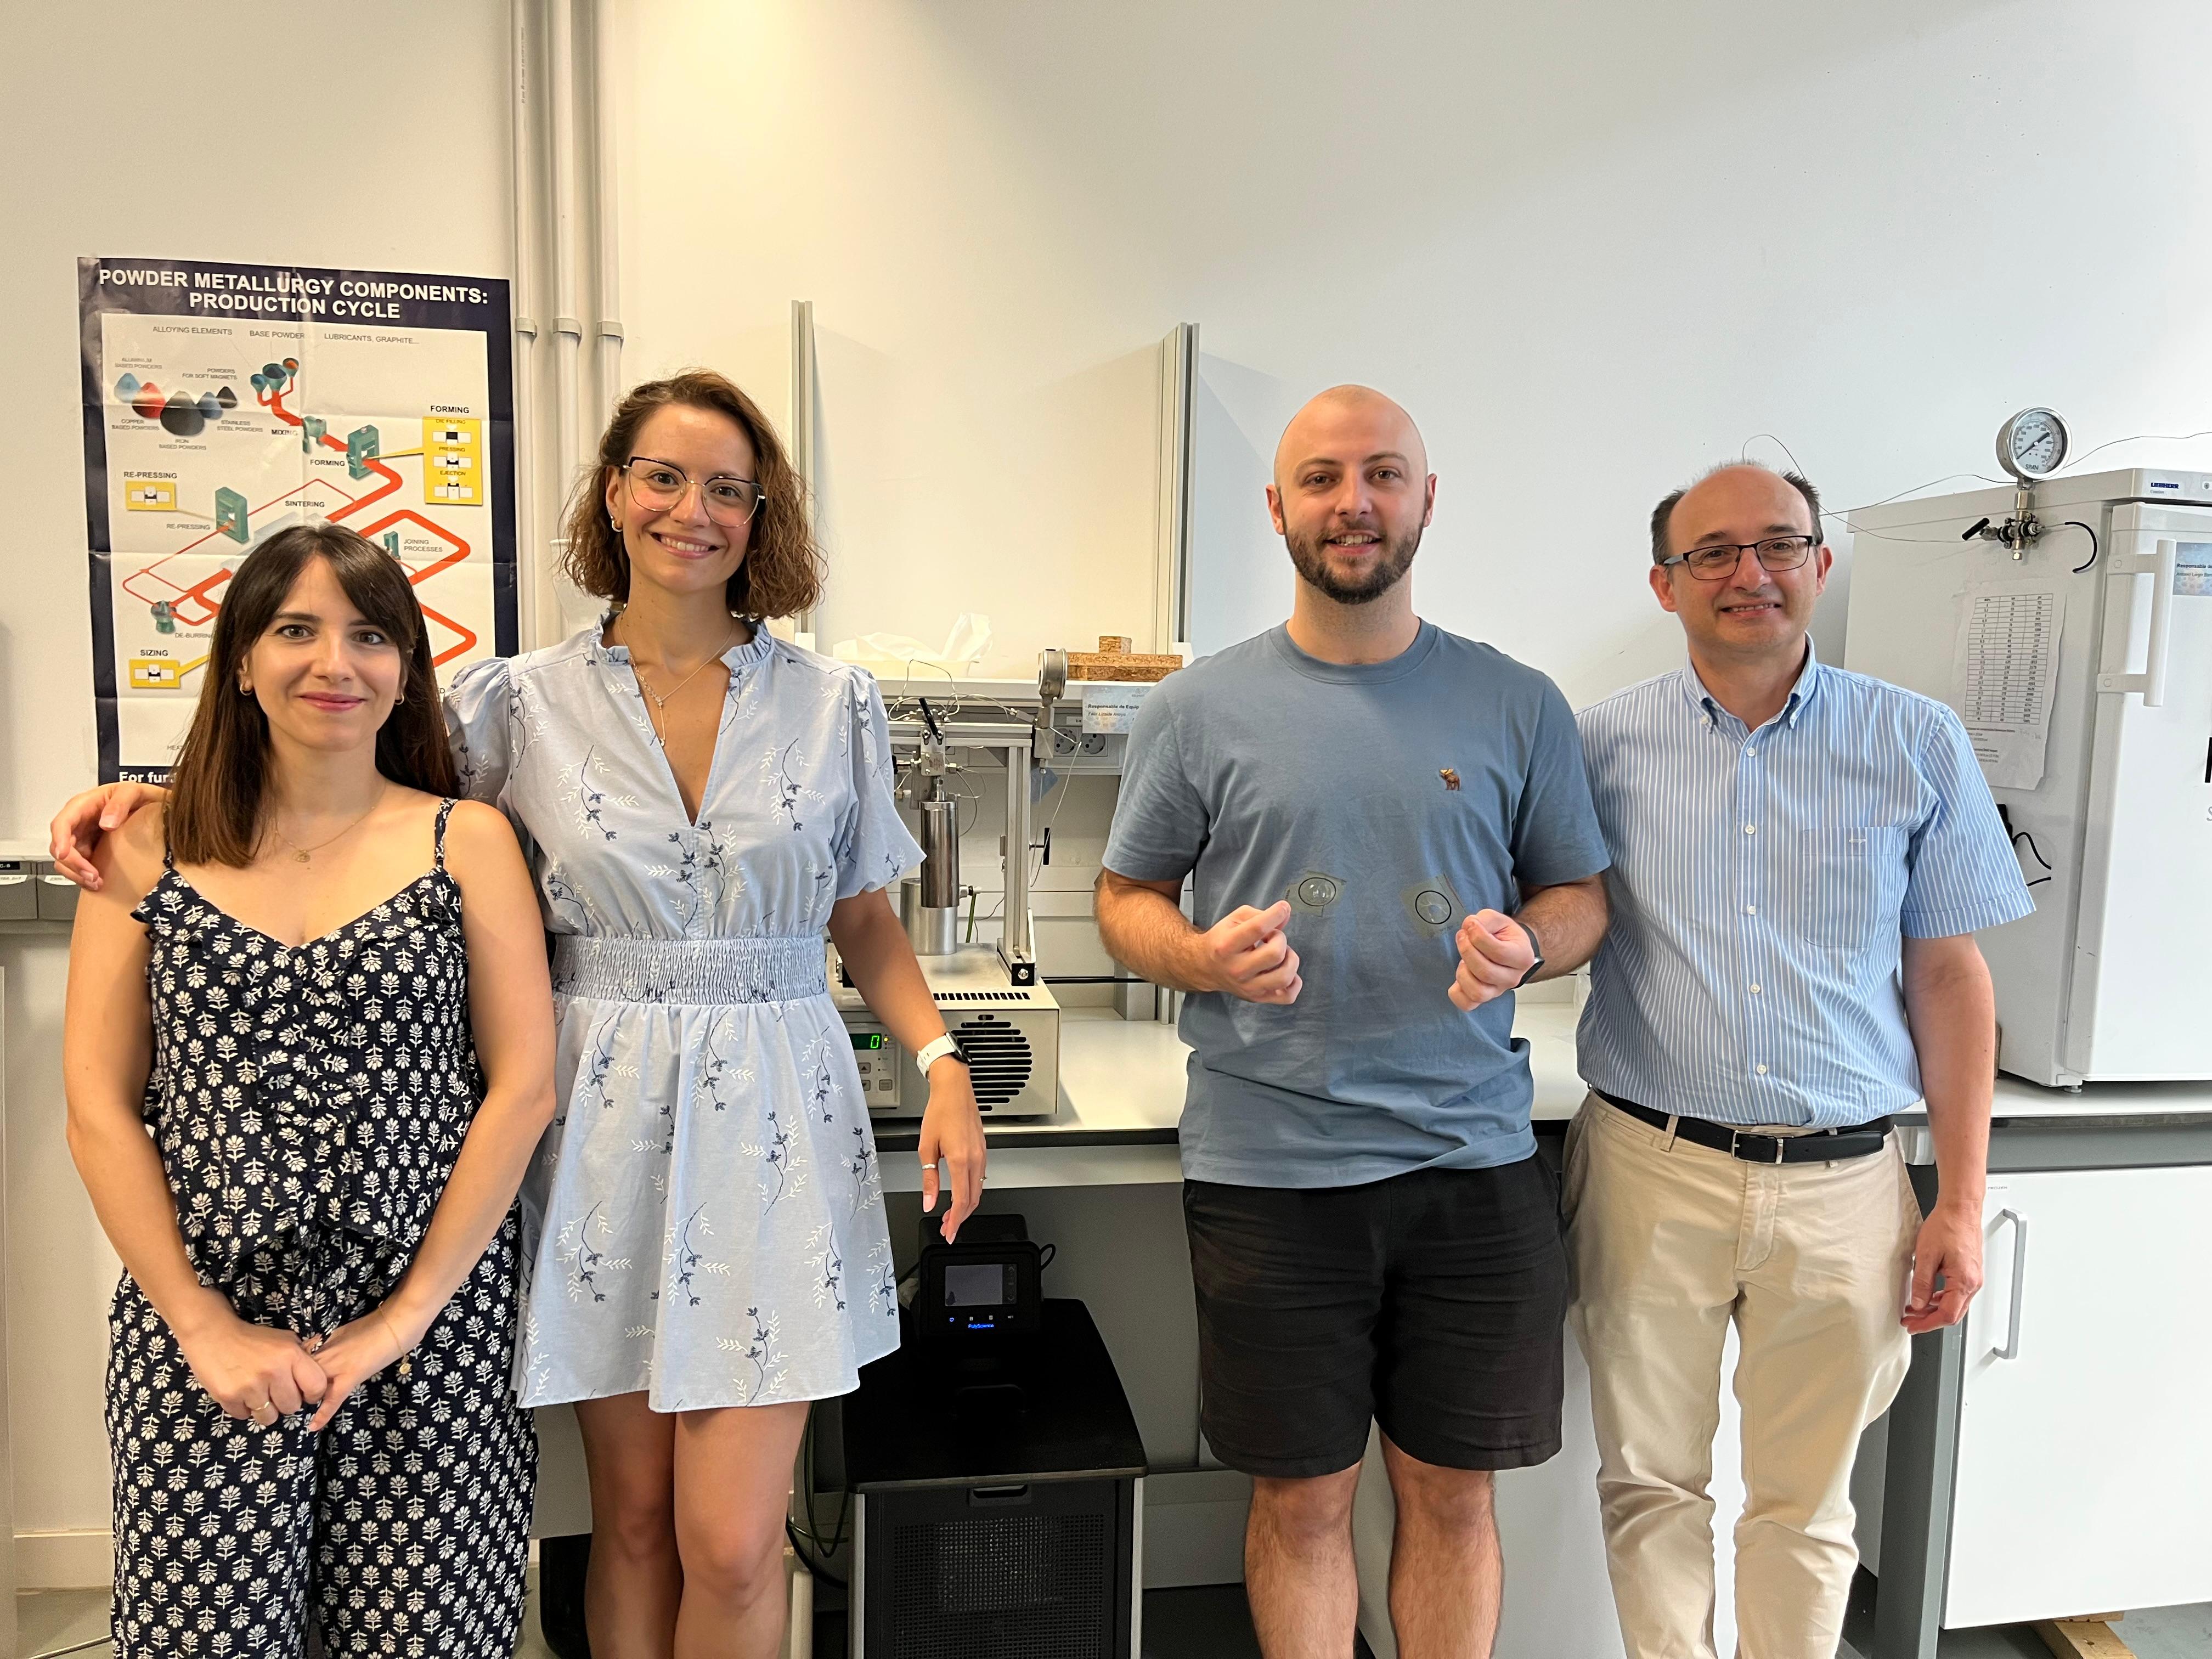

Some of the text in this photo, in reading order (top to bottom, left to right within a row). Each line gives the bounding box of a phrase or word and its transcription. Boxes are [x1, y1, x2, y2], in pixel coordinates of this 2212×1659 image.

[99, 269, 488, 304] POWDER METALLURGY COMPONENTS:
[189, 292, 400, 318] PRODUCTION CYCLE
[191, 327, 233, 335] ELEMENTS
[431, 405, 470, 414] FORMING
[119, 771, 144, 783] For
[870, 1035, 880, 1048] 0
